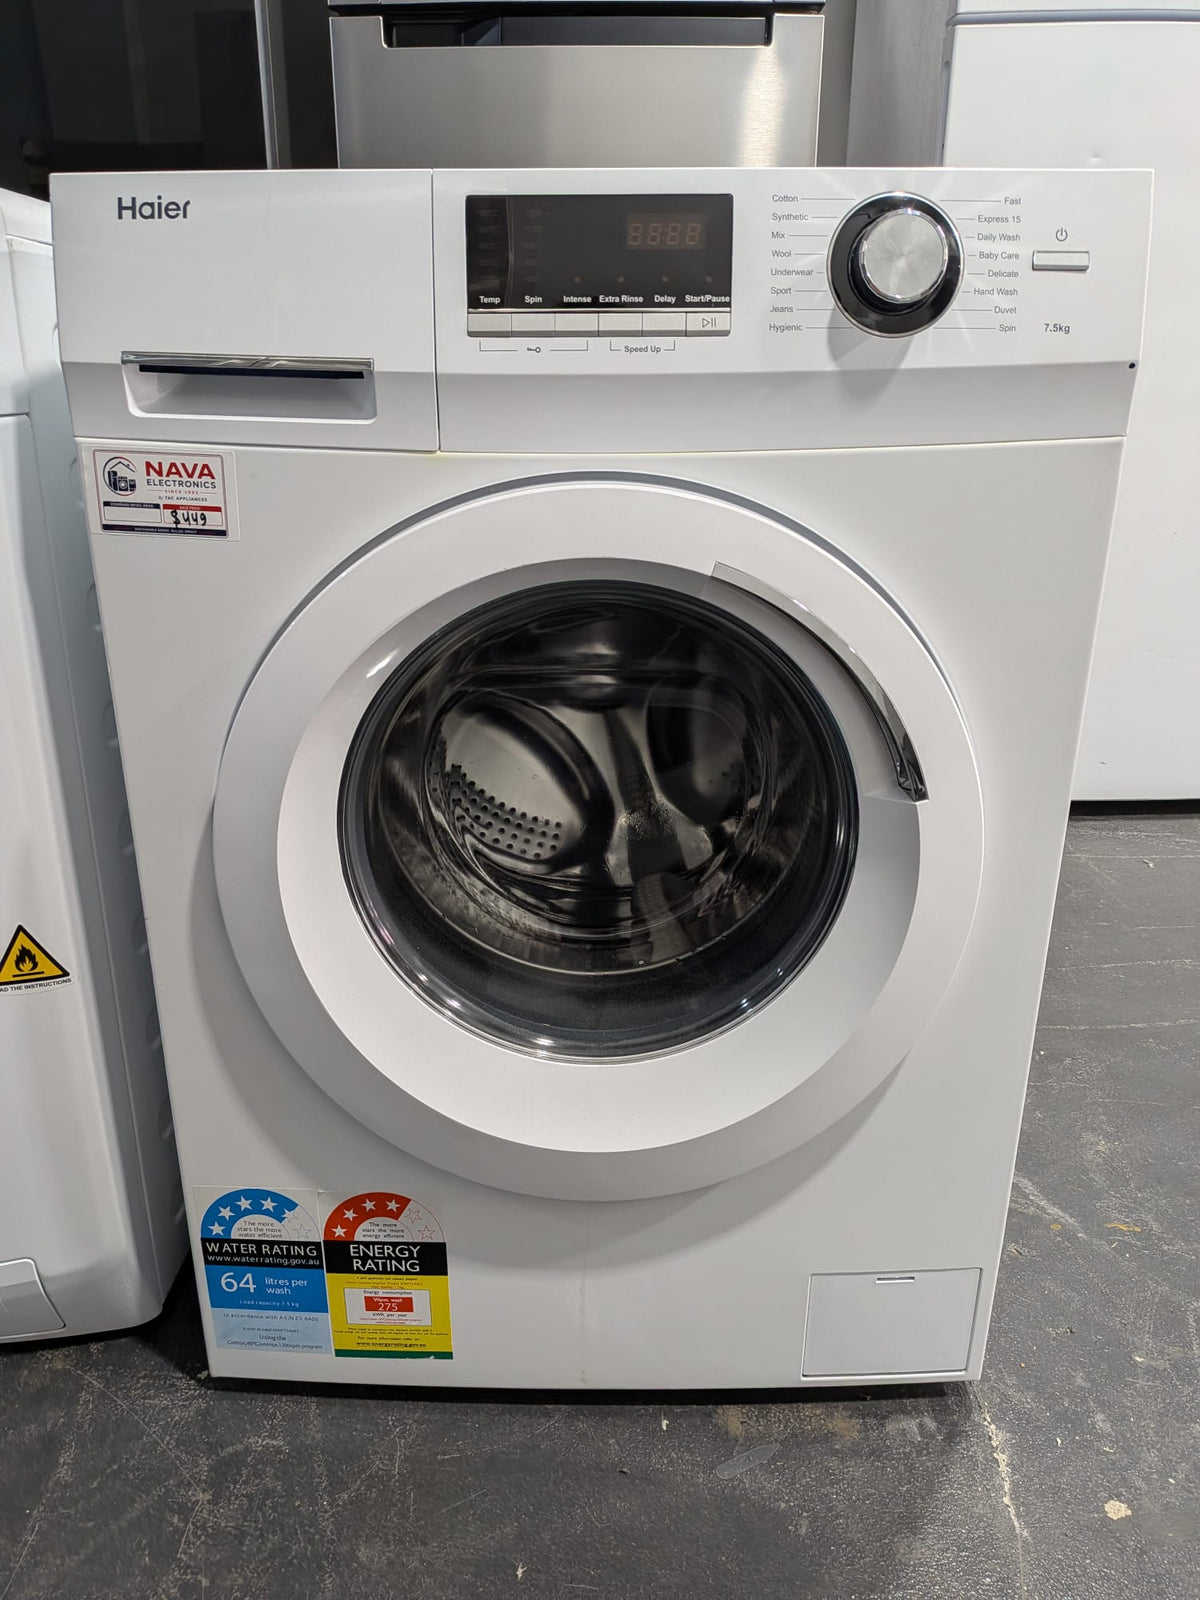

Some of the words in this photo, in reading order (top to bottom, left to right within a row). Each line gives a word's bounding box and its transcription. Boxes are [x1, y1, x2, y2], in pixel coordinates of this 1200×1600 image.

[772, 194, 799, 203] Cotton
[1004, 197, 1021, 205] Fast
[117, 195, 191, 220] Haier
[771, 213, 809, 222] Synthetic
[977, 215, 1009, 224] Express
[1011, 215, 1021, 223] 15
[771, 231, 785, 239] Mix
[977, 233, 997, 242] Daily
[999, 233, 1021, 241] Wash
[771, 250, 792, 258] Wool
[979, 252, 998, 261] Baby
[770, 268, 814, 276] Underwear
[987, 269, 1019, 277] Delicate
[770, 287, 792, 295] Sport
[973, 288, 995, 296] Hand
[996, 288, 1018, 296] Wash
[479, 295, 501, 304] Temp
[524, 295, 543, 304] Spin
[563, 295, 592, 303] Intense
[599, 295, 620, 303] Extra
[621, 295, 644, 303] Rinse
[654, 295, 676, 304] Delay
[685, 295, 730, 303] Start/Pause
[769, 305, 794, 313] Jeans
[994, 306, 1017, 314] Duvet
[769, 323, 803, 332] Hygienic
[999, 324, 1016, 333] Spin
[1044, 323, 1071, 334] 7.5kg
[624, 345, 648, 354] Speed
[650, 345, 661, 354] Up
[145, 461, 216, 479] NAVA
[146, 478, 217, 489] ELECTRONICS
[170, 509, 207, 530] $449
[24, 978, 72, 989] INSTRUCTIONS
[205, 1241, 257, 1255] WATER
[262, 1244, 317, 1257] RATING
[349, 1244, 421, 1258] ENERGY
[207, 1255, 320, 1266] www.waterrating.gov.au
[353, 1259, 420, 1272] RATING
[221, 1272, 256, 1293] 64
[265, 1276, 290, 1286] litres
[291, 1279, 308, 1288] per
[266, 1286, 291, 1295] wash
[378, 1302, 398, 1311] 275
